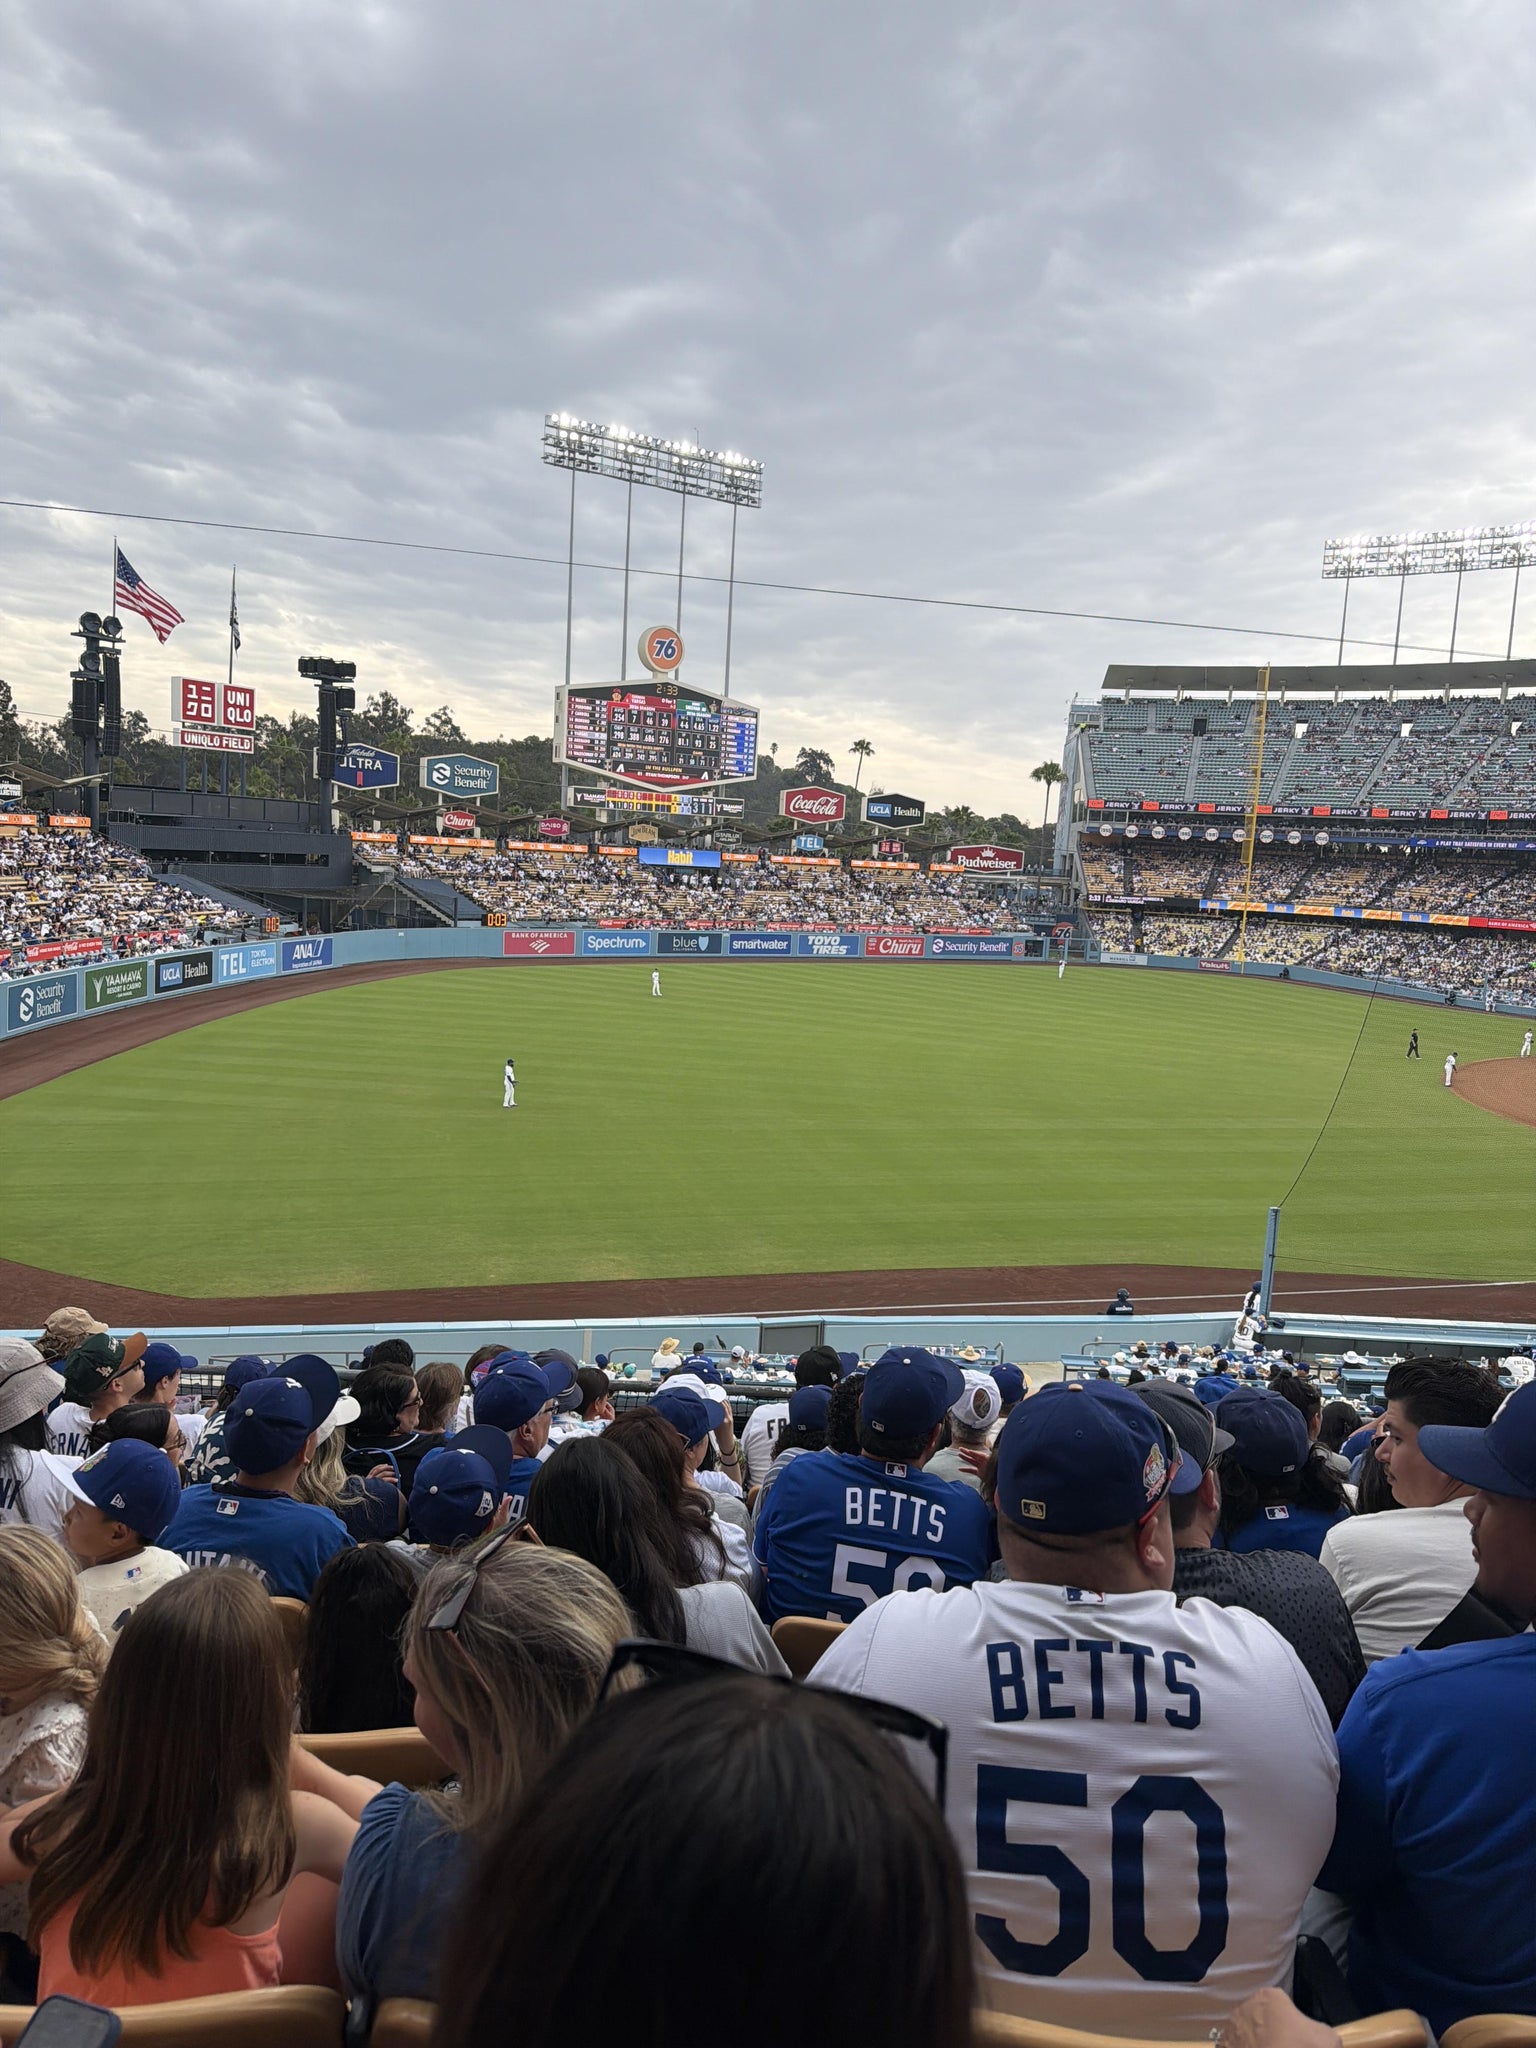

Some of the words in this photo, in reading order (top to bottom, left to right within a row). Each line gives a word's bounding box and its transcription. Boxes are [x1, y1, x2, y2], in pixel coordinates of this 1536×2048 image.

[652, 638, 677, 660] 76
[187, 684, 212, 701] ユニ
[656, 684, 678, 696] 2:33
[226, 690, 250, 707] UNI
[186, 702, 212, 718] クロ
[226, 707, 252, 724] QLO
[633, 715, 636, 723] 7
[646, 717, 653, 725] 46
[694, 723, 704, 731] 4.65
[709, 724, 719, 732] 1.22
[184, 732, 220, 747] UNIQLO
[222, 736, 250, 750] FIELD
[659, 736, 669, 744] 276
[710, 741, 716, 749] 25
[454, 765, 492, 779] Security
[455, 777, 488, 789] Benefit
[790, 794, 840, 816] Coca-Cola
[870, 806, 890, 815] UCLA
[894, 807, 920, 817] Health
[445, 815, 474, 826] Churu
[642, 826, 656, 836] BEAM
[800, 837, 820, 848] TEL
[668, 851, 693, 864] Habit
[958, 856, 1016, 869] Budweiser
[487, 913, 506, 926] 0:03
[1055, 927, 1073, 938] 76
[587, 935, 643, 951] Spectrum
[673, 936, 697, 948] blue
[732, 939, 788, 950] smartwater
[808, 936, 840, 945] TOYO
[879, 938, 921, 954] Churu
[251, 950, 266, 958] TOKYO
[292, 943, 313, 960] ANA
[812, 946, 847, 955] TIRES
[945, 941, 979, 954] Security
[980, 942, 1008, 952] Benefit
[220, 953, 247, 976] TEL
[251, 957, 275, 968] ELECTRON
[1200, 962, 1230, 970] Yakult
[163, 967, 180, 981] UCLA
[184, 961, 208, 979] Health
[36, 982, 65, 1000] Security
[107, 985, 122, 994] RESORT
[126, 982, 141, 991] CASINO
[36, 999, 62, 1018] Benefit
[96, 1365, 113, 1378] LA
[846, 1487, 946, 1543] BETTS
[986, 1638, 1201, 1730] BETTS
[974, 1763, 1230, 1983] 50
